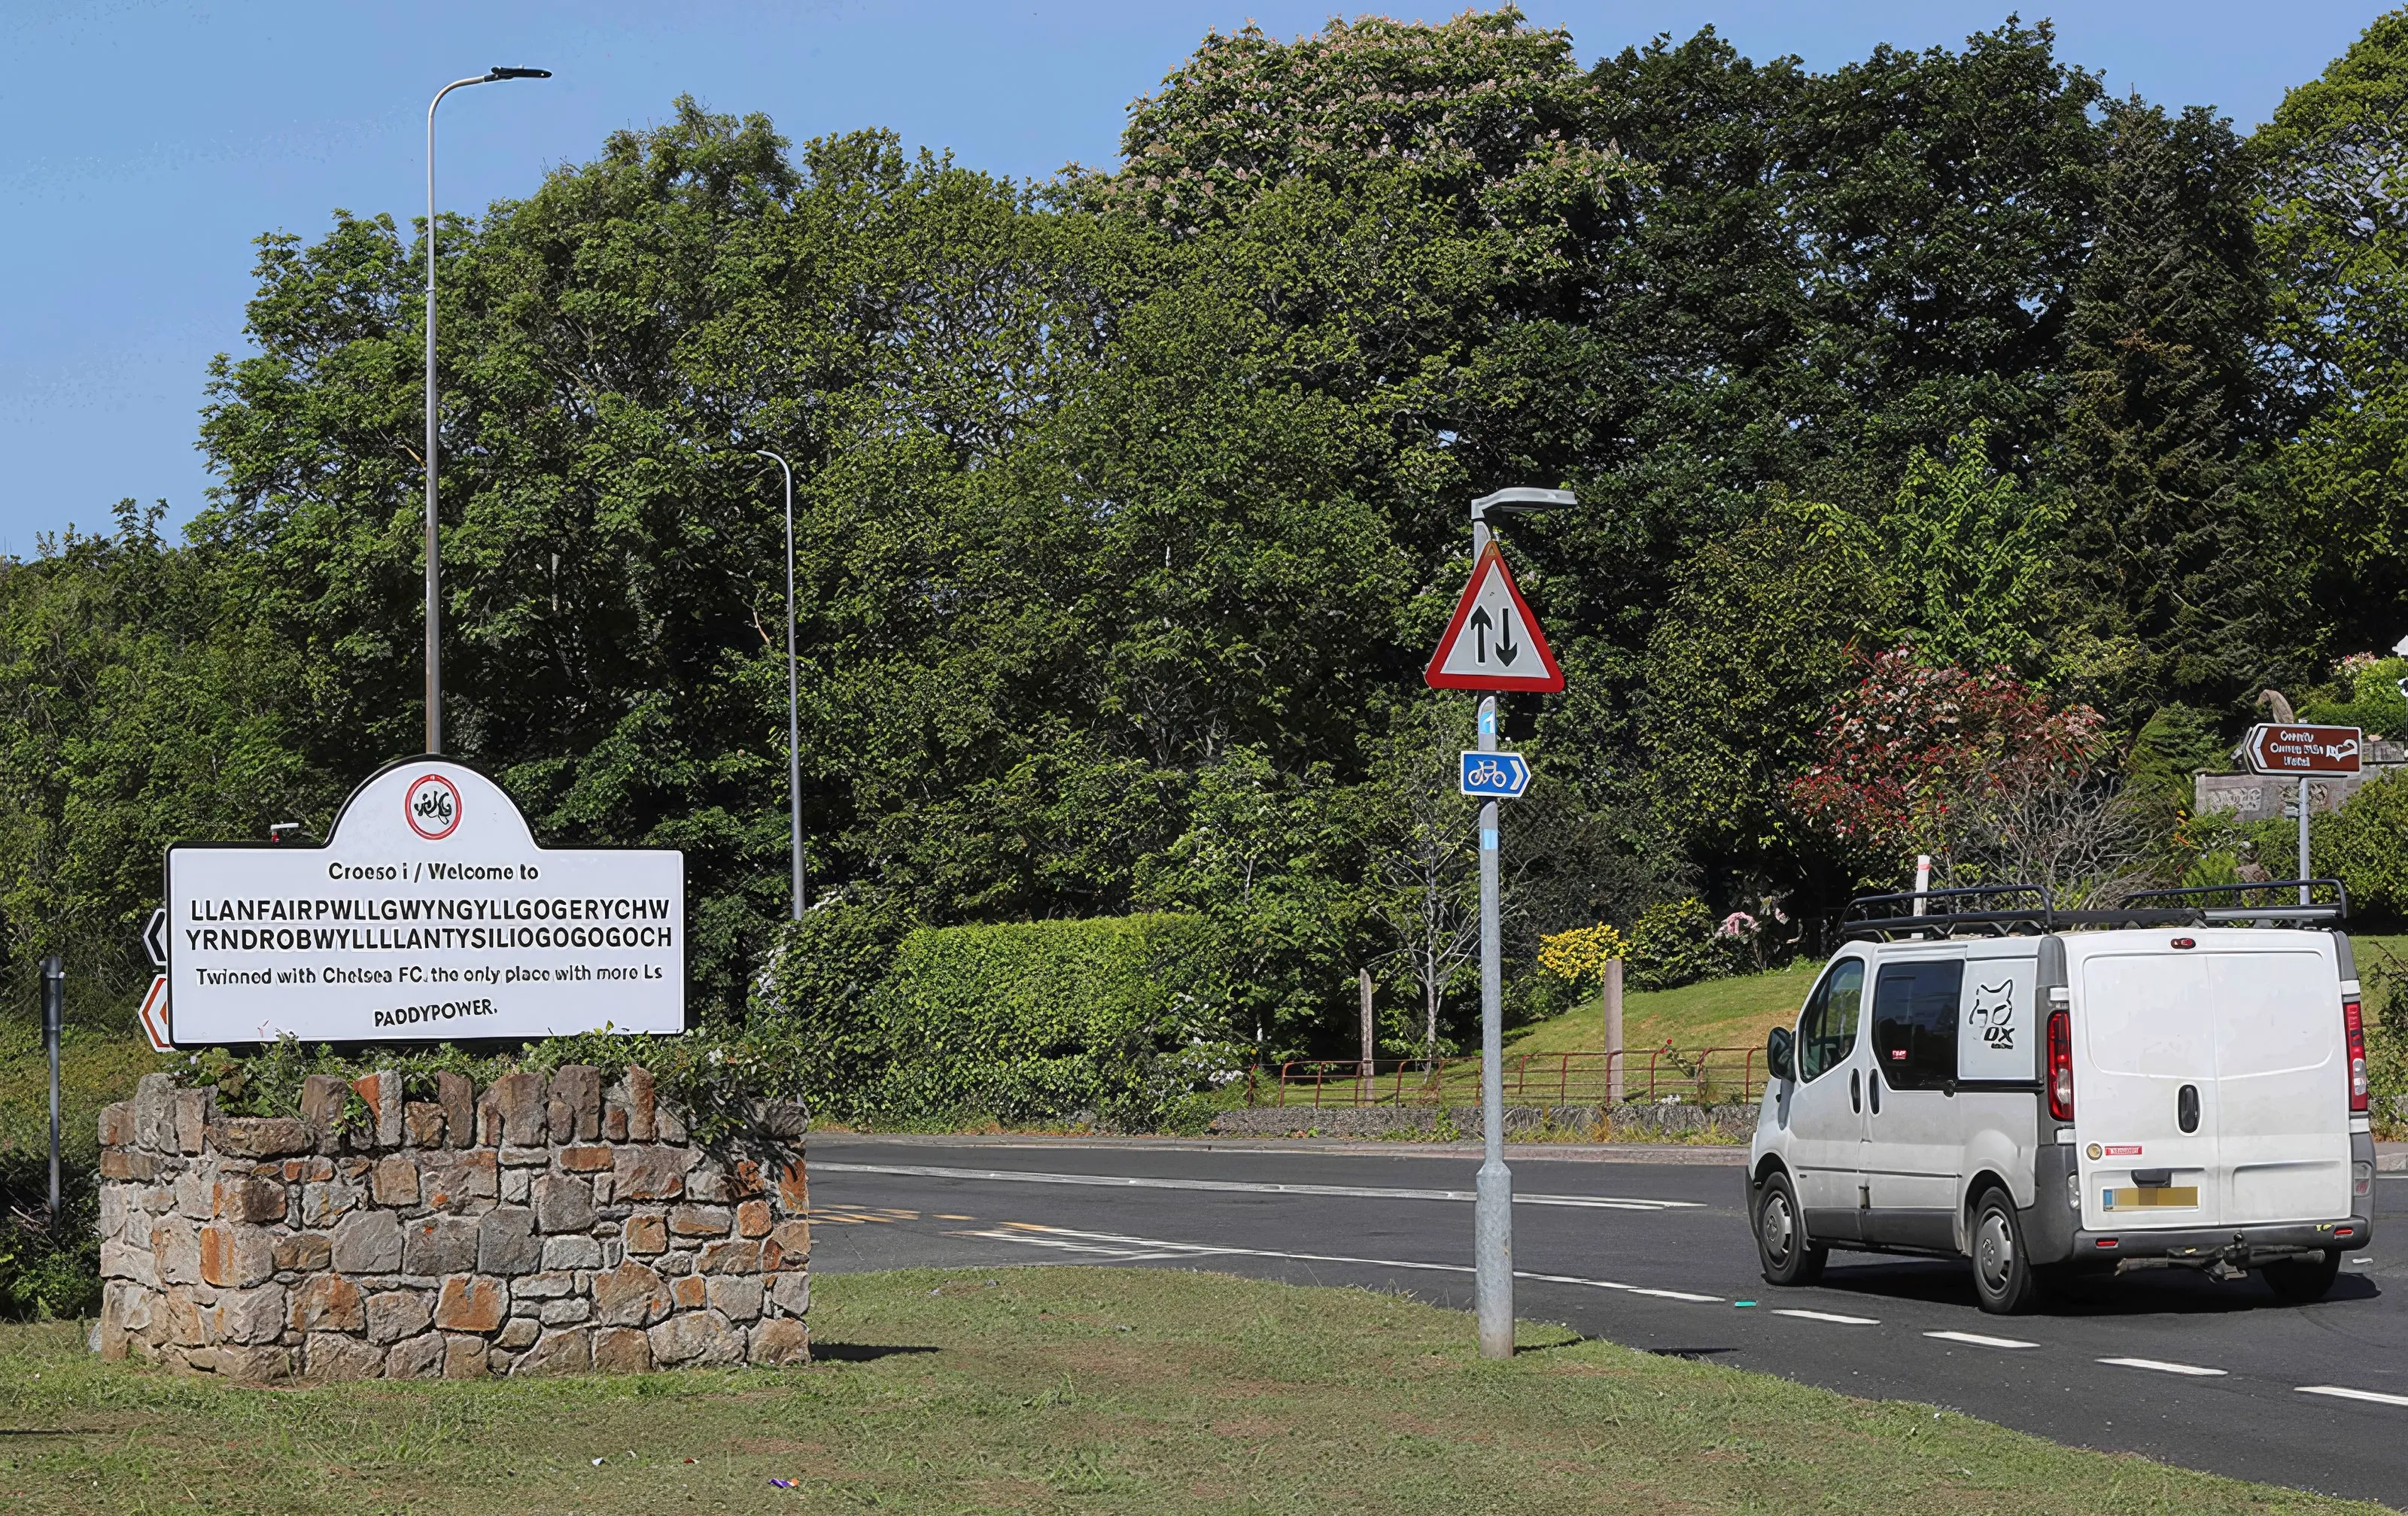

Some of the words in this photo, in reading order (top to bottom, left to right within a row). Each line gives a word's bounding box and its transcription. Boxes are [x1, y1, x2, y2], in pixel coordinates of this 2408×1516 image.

[329, 862, 397, 880] Croeso
[403, 862, 407, 880] i
[428, 863, 514, 880] Welcome
[520, 864, 539, 880] to
[191, 899, 670, 921] LLANFAIRPWLLGWYNGYLLGOGERYCHW
[186, 926, 671, 951] YRNDROBWYLLLLANTYSILIOGOGOGOCH
[196, 968, 272, 985] Twinned
[277, 968, 316, 984] with
[323, 967, 393, 984] Chelsea
[430, 968, 459, 983] the
[464, 966, 500, 985] only
[506, 966, 550, 983] place
[555, 965, 591, 981] with
[597, 968, 638, 980] more
[644, 965, 664, 980] Ls
